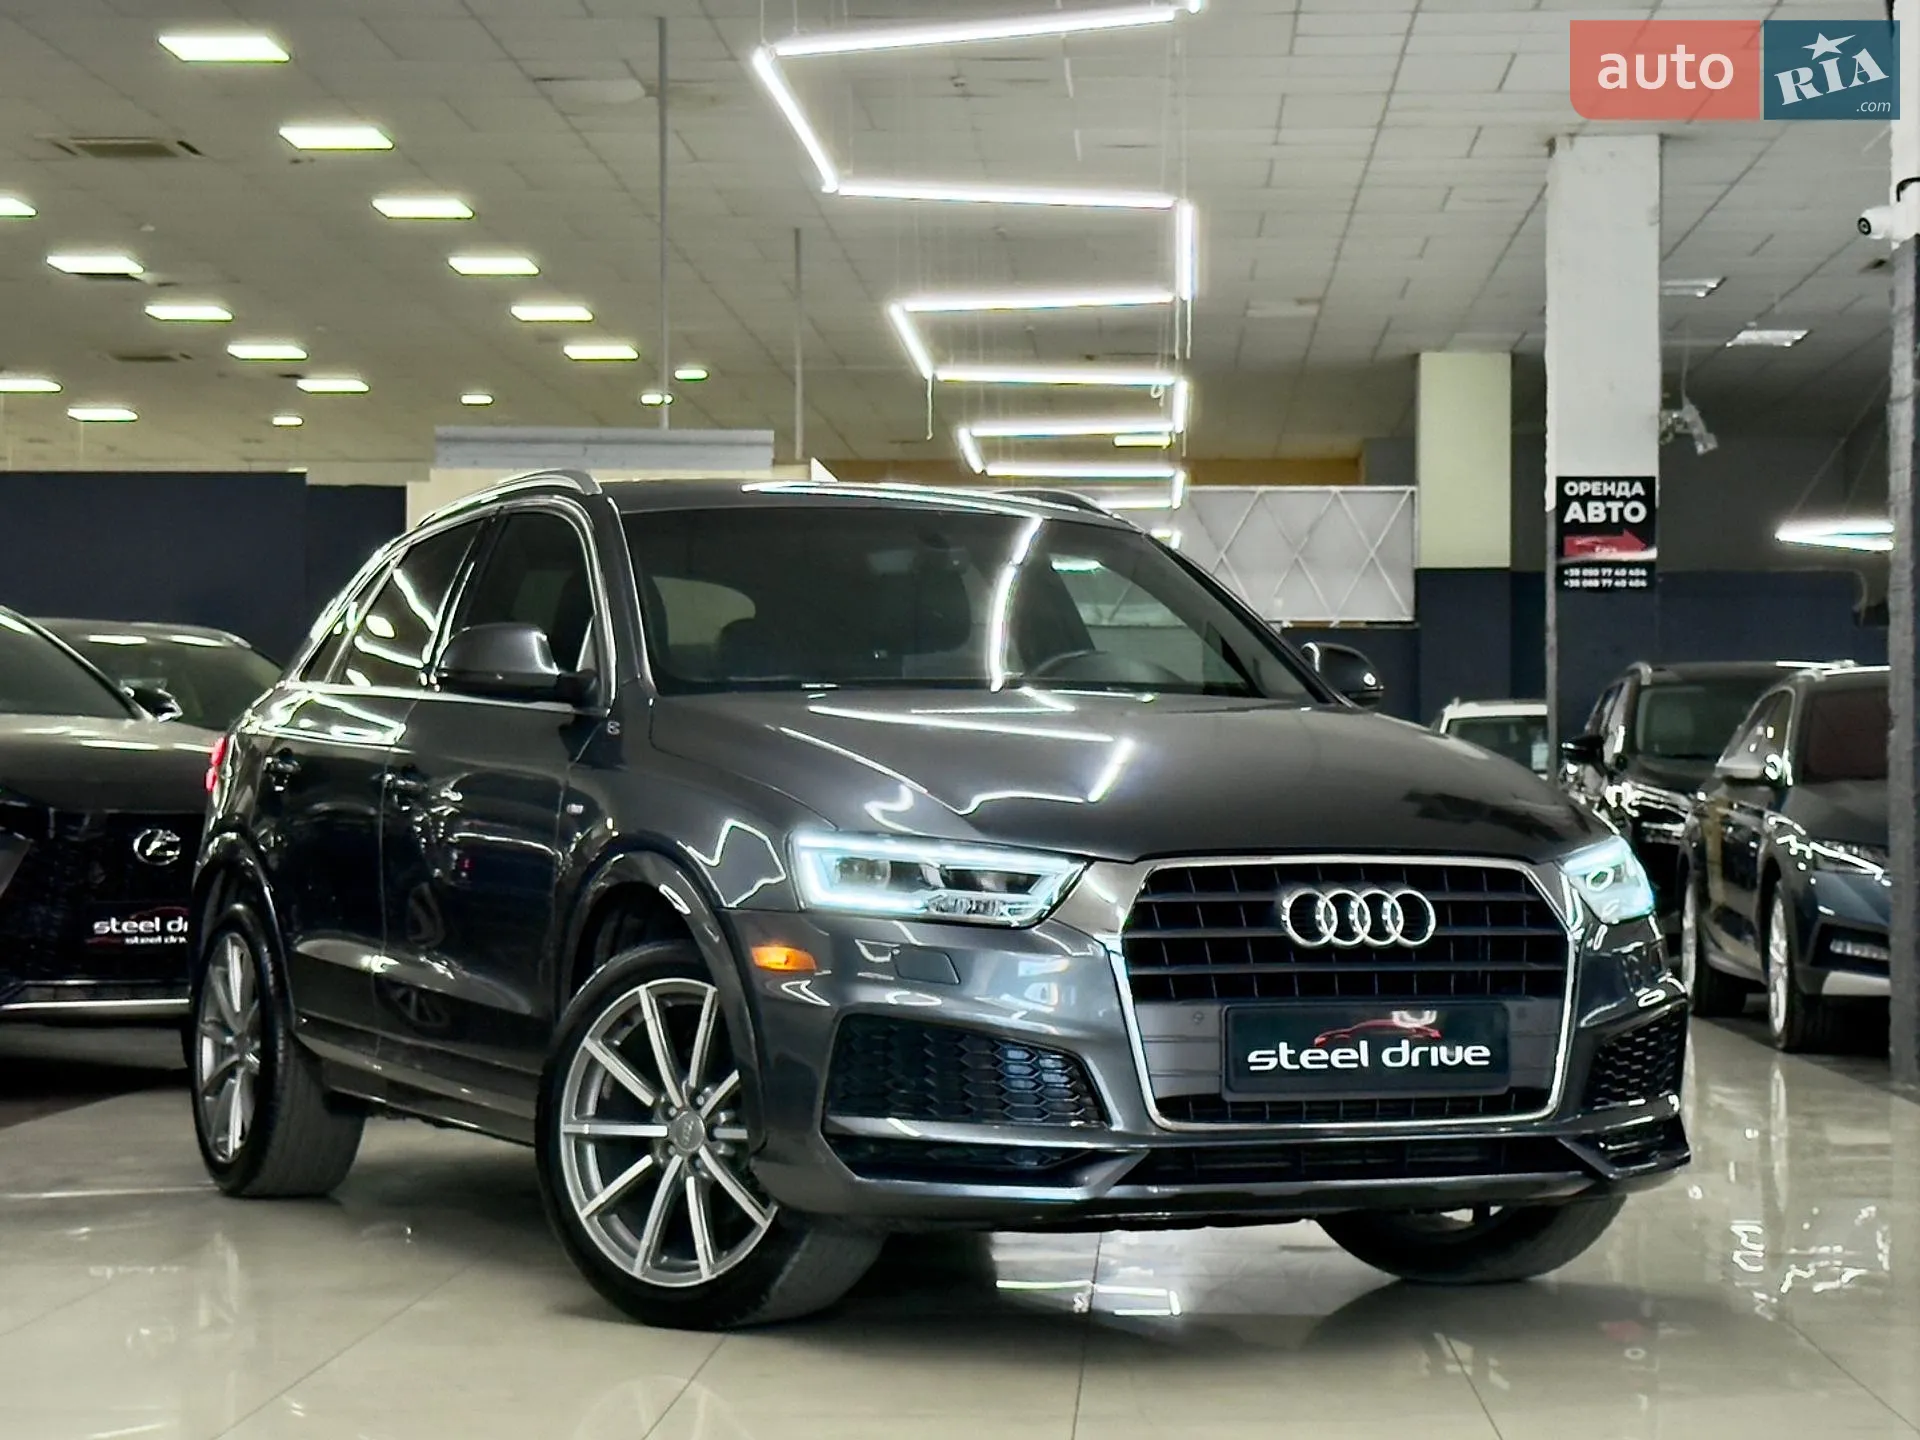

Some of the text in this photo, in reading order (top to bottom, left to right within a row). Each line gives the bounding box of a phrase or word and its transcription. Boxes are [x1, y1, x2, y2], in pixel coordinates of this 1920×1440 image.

[1564, 481, 1645, 498] ОРЕНДА
[1563, 501, 1647, 523] АВТО
[94, 916, 160, 934] steel
[1248, 1039, 1490, 1071] steel drive
